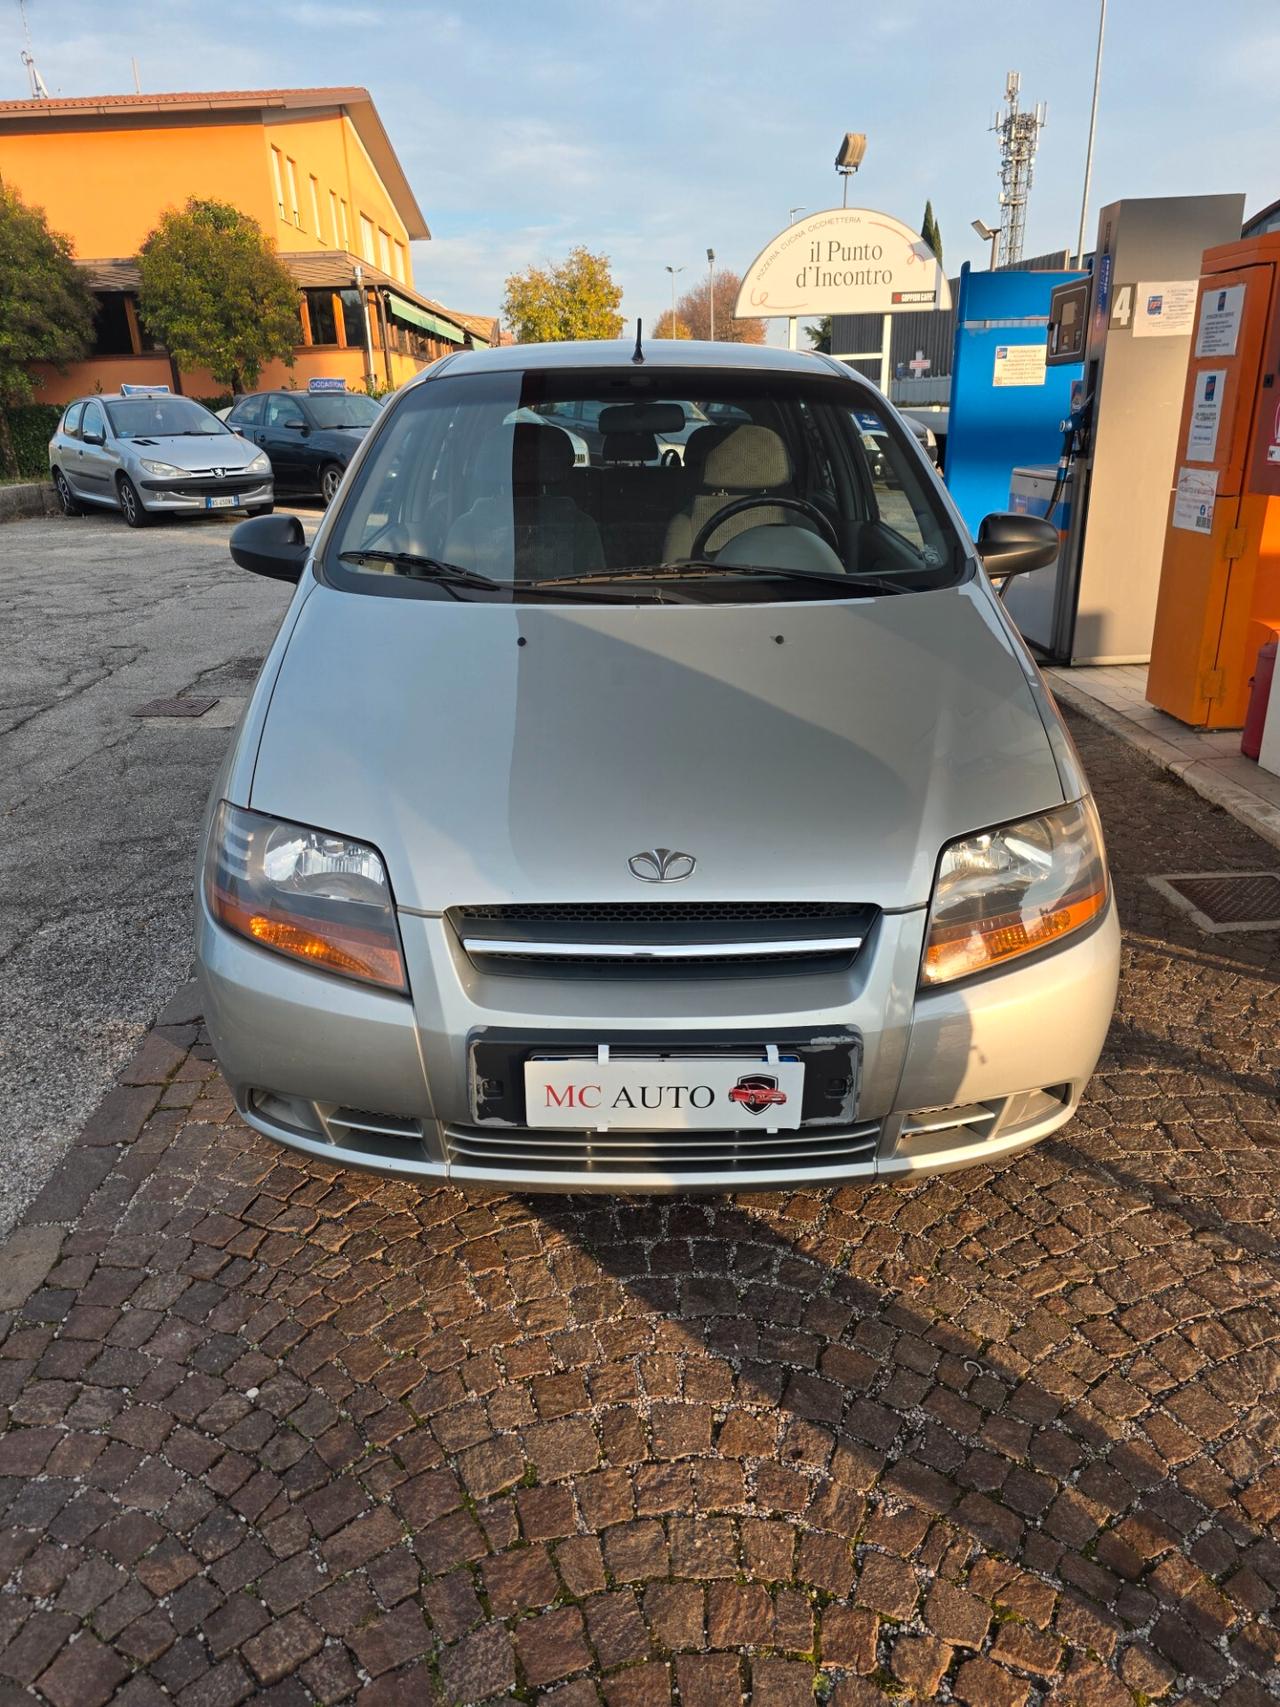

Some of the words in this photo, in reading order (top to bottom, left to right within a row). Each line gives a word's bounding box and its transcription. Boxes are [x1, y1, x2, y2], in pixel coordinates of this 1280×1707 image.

[756, 250, 780, 280] PIZZERIA
[781, 229, 806, 251] CUCINA
[807, 216, 862, 233] CICCHETTERIA
[809, 240, 821, 263] il
[827, 240, 883, 263] Punto
[795, 264, 893, 289] d'Incontro
[1112, 286, 1132, 326] 4
[543, 1083, 602, 1109] MC
[610, 1084, 716, 1110] AUTO
